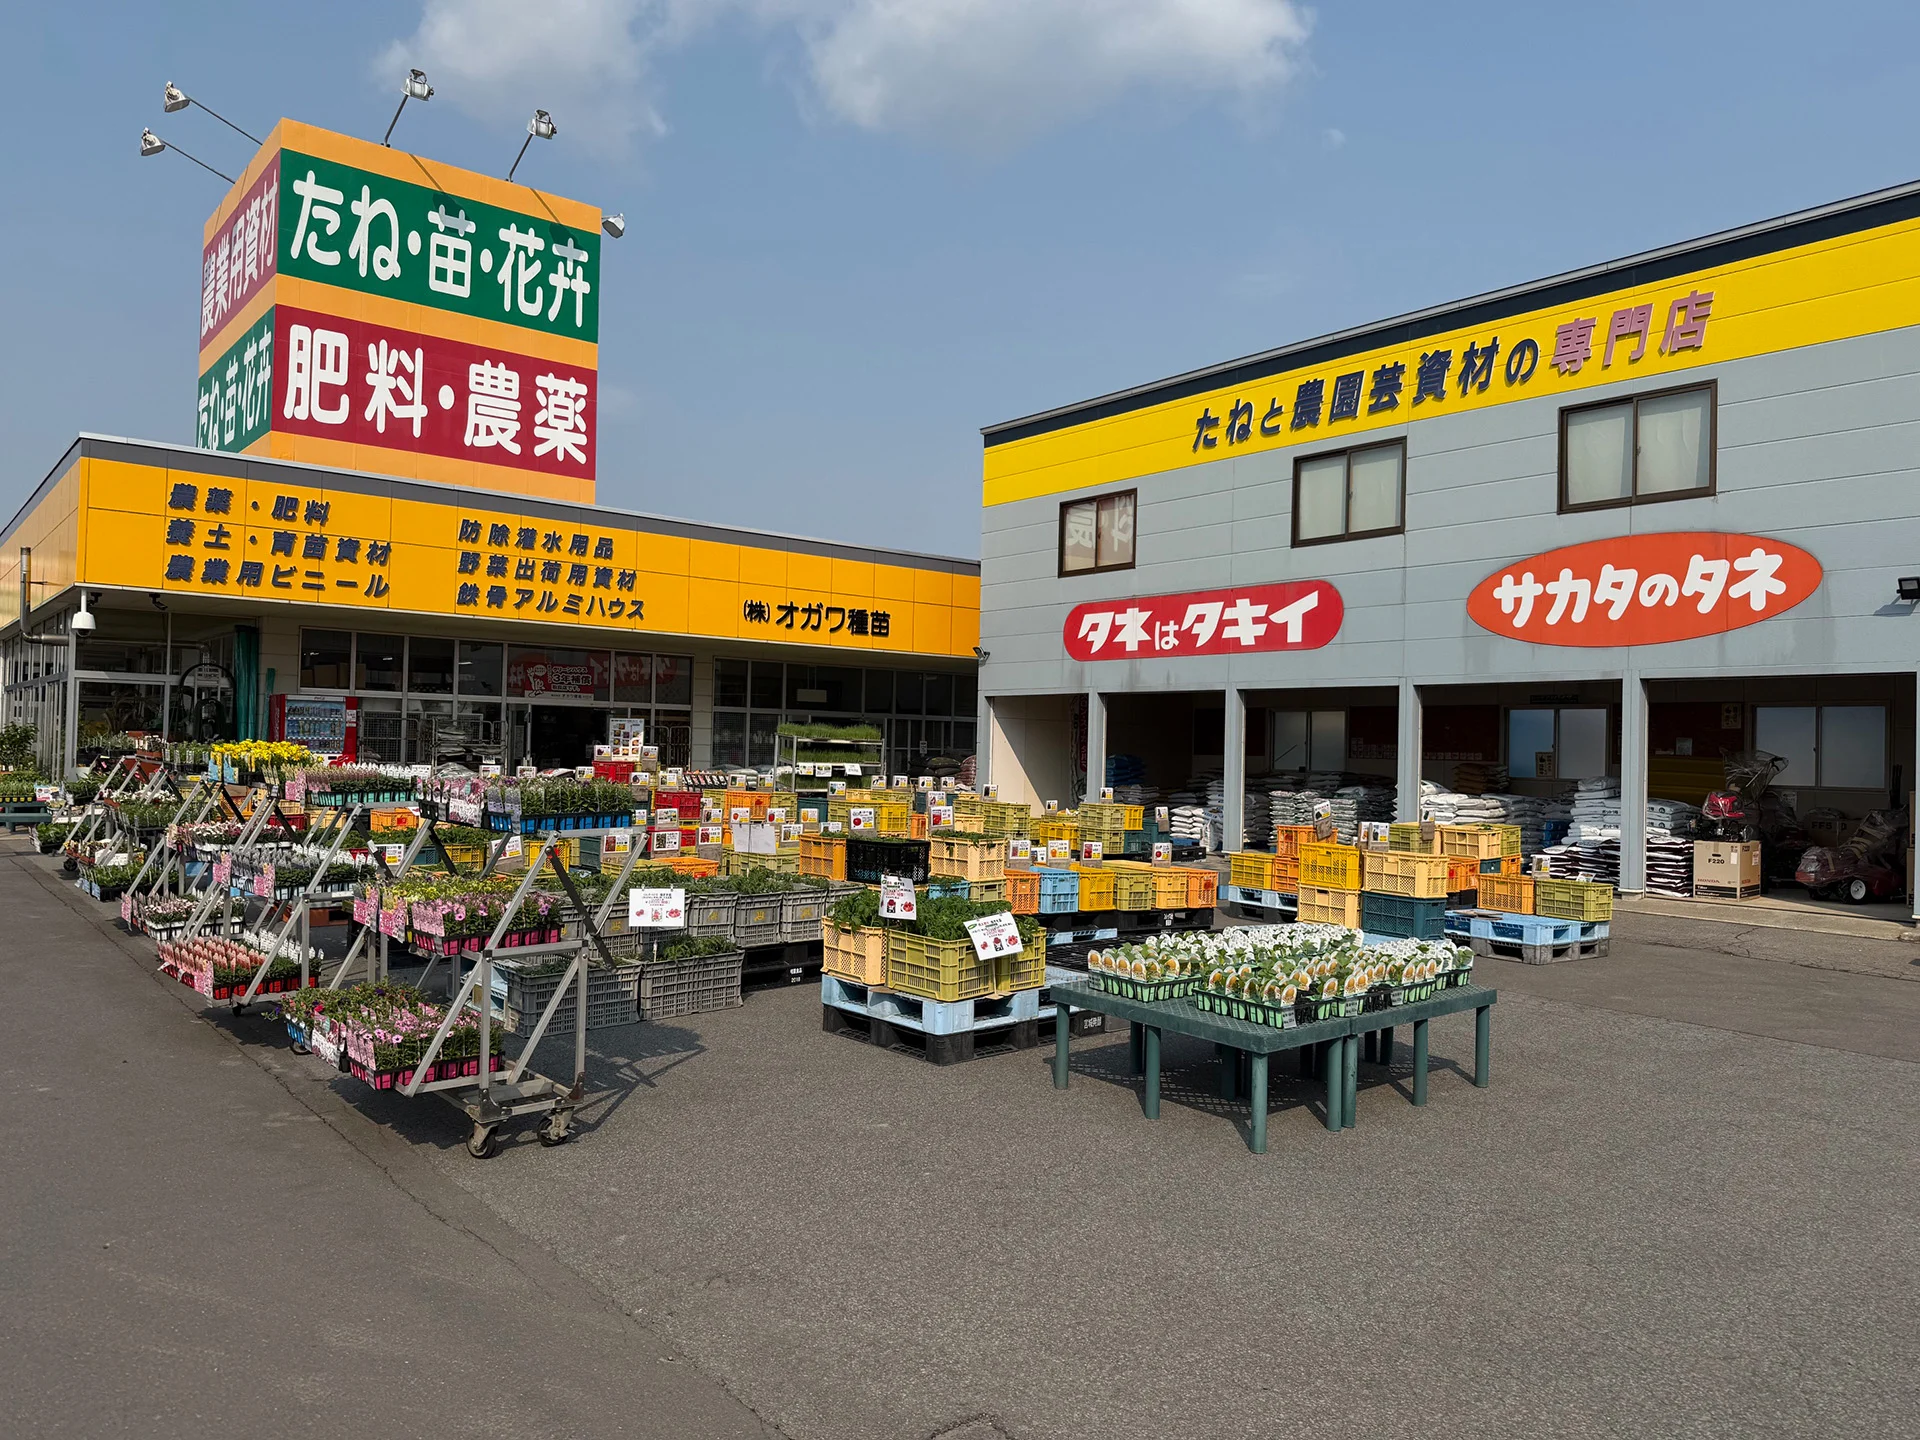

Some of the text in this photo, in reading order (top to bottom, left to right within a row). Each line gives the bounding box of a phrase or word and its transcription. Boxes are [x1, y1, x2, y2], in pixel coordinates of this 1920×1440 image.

[201, 169, 278, 340] 農業用資材
[291, 170, 592, 328] たね・苗・花卉
[283, 324, 588, 465] 肥料・農薬
[1192, 289, 1716, 452] たねと農園芸資材の専門店
[168, 483, 332, 527] 農薬・肥料
[456, 551, 638, 593] 野菜出荷用資材
[457, 518, 615, 561] 防除灌水用品
[164, 554, 391, 599] 農業用ビニール
[456, 581, 646, 622] 鉄骨アルミハウス
[1493, 546, 1787, 629] サカタのタネ
[1077, 588, 1322, 653] タネはタキイ
